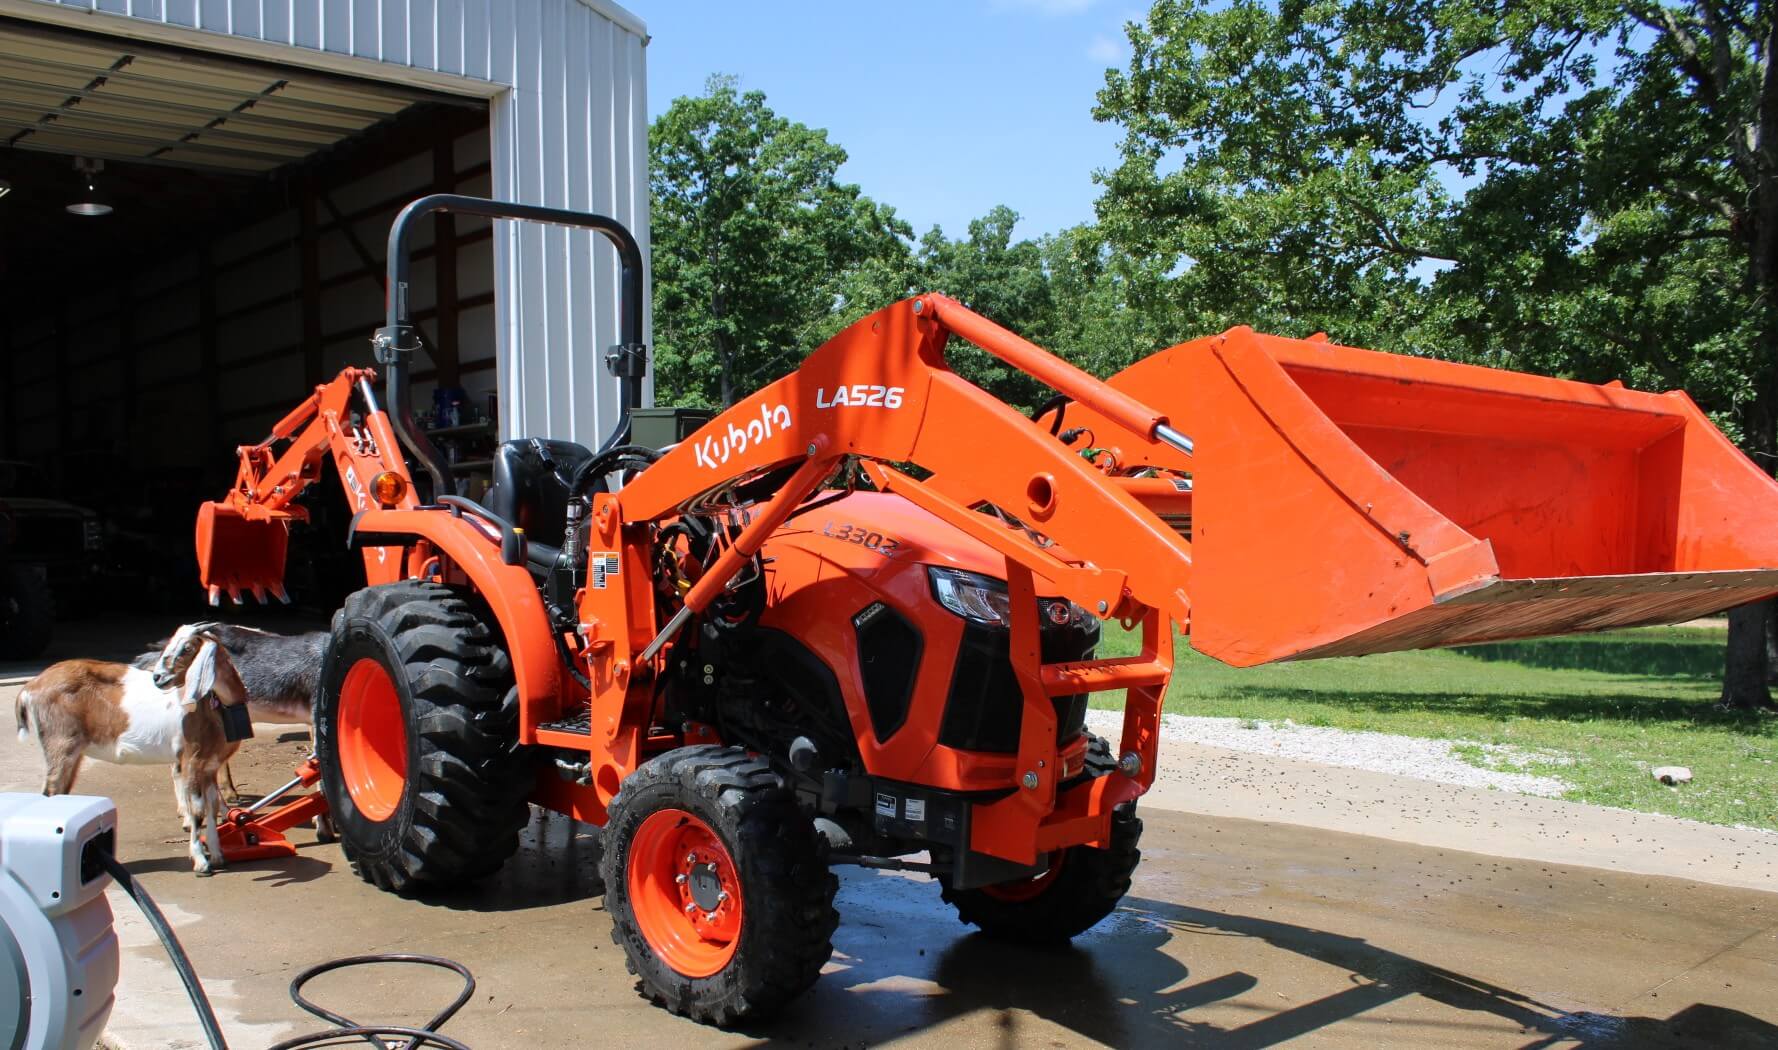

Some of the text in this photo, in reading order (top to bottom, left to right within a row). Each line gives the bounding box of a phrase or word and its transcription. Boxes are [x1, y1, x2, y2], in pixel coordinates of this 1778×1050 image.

[816, 385, 905, 409] LA526
[694, 403, 792, 469] Kubota
[823, 520, 901, 557] L3302
